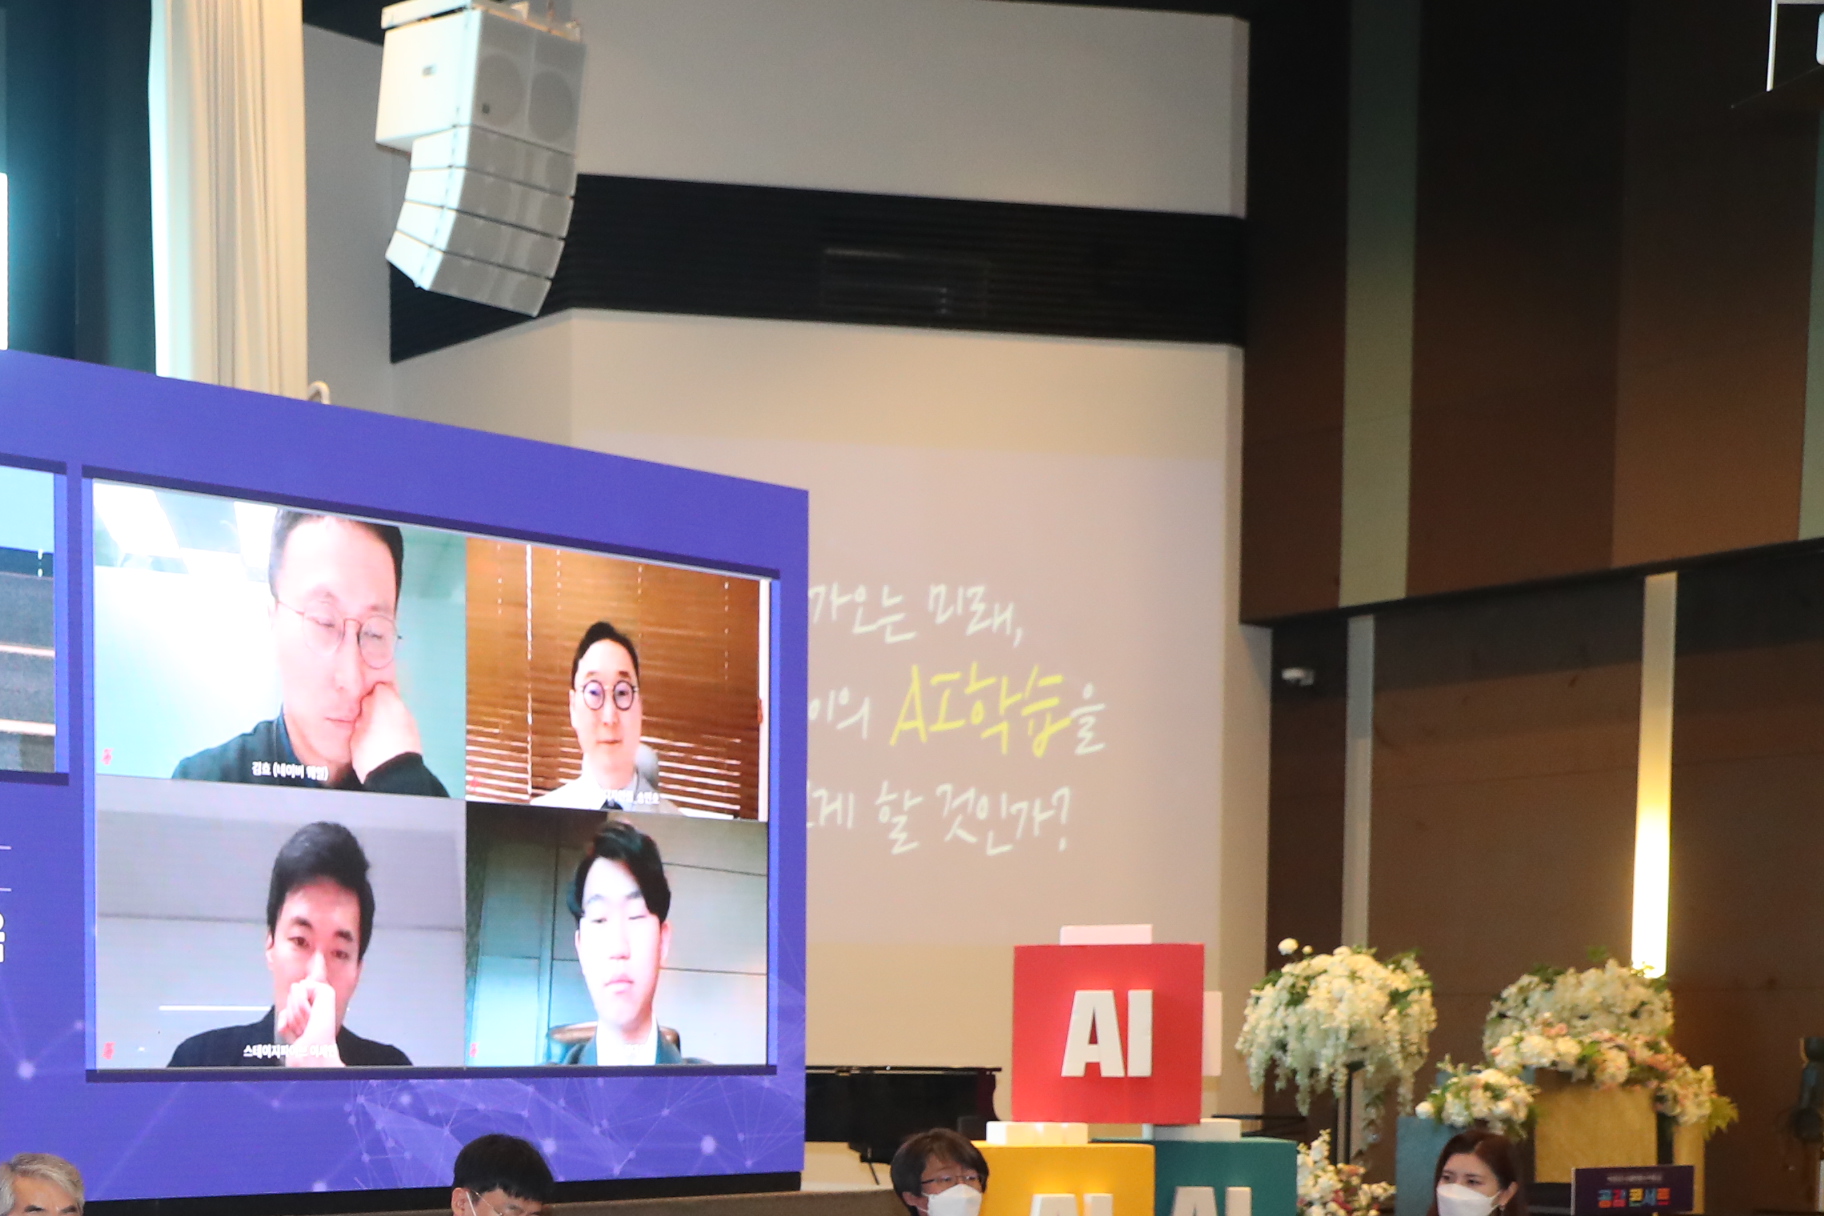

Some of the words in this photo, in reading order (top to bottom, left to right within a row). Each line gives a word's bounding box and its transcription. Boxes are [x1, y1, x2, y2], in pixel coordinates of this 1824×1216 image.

[928, 582, 1023, 648] 미래,
[889, 660, 1107, 758] AI학습을
[806, 779, 856, 829] 게
[876, 780, 924, 855] 할
[935, 783, 1071, 856] 것인가?
[1061, 989, 1153, 1077] AI
